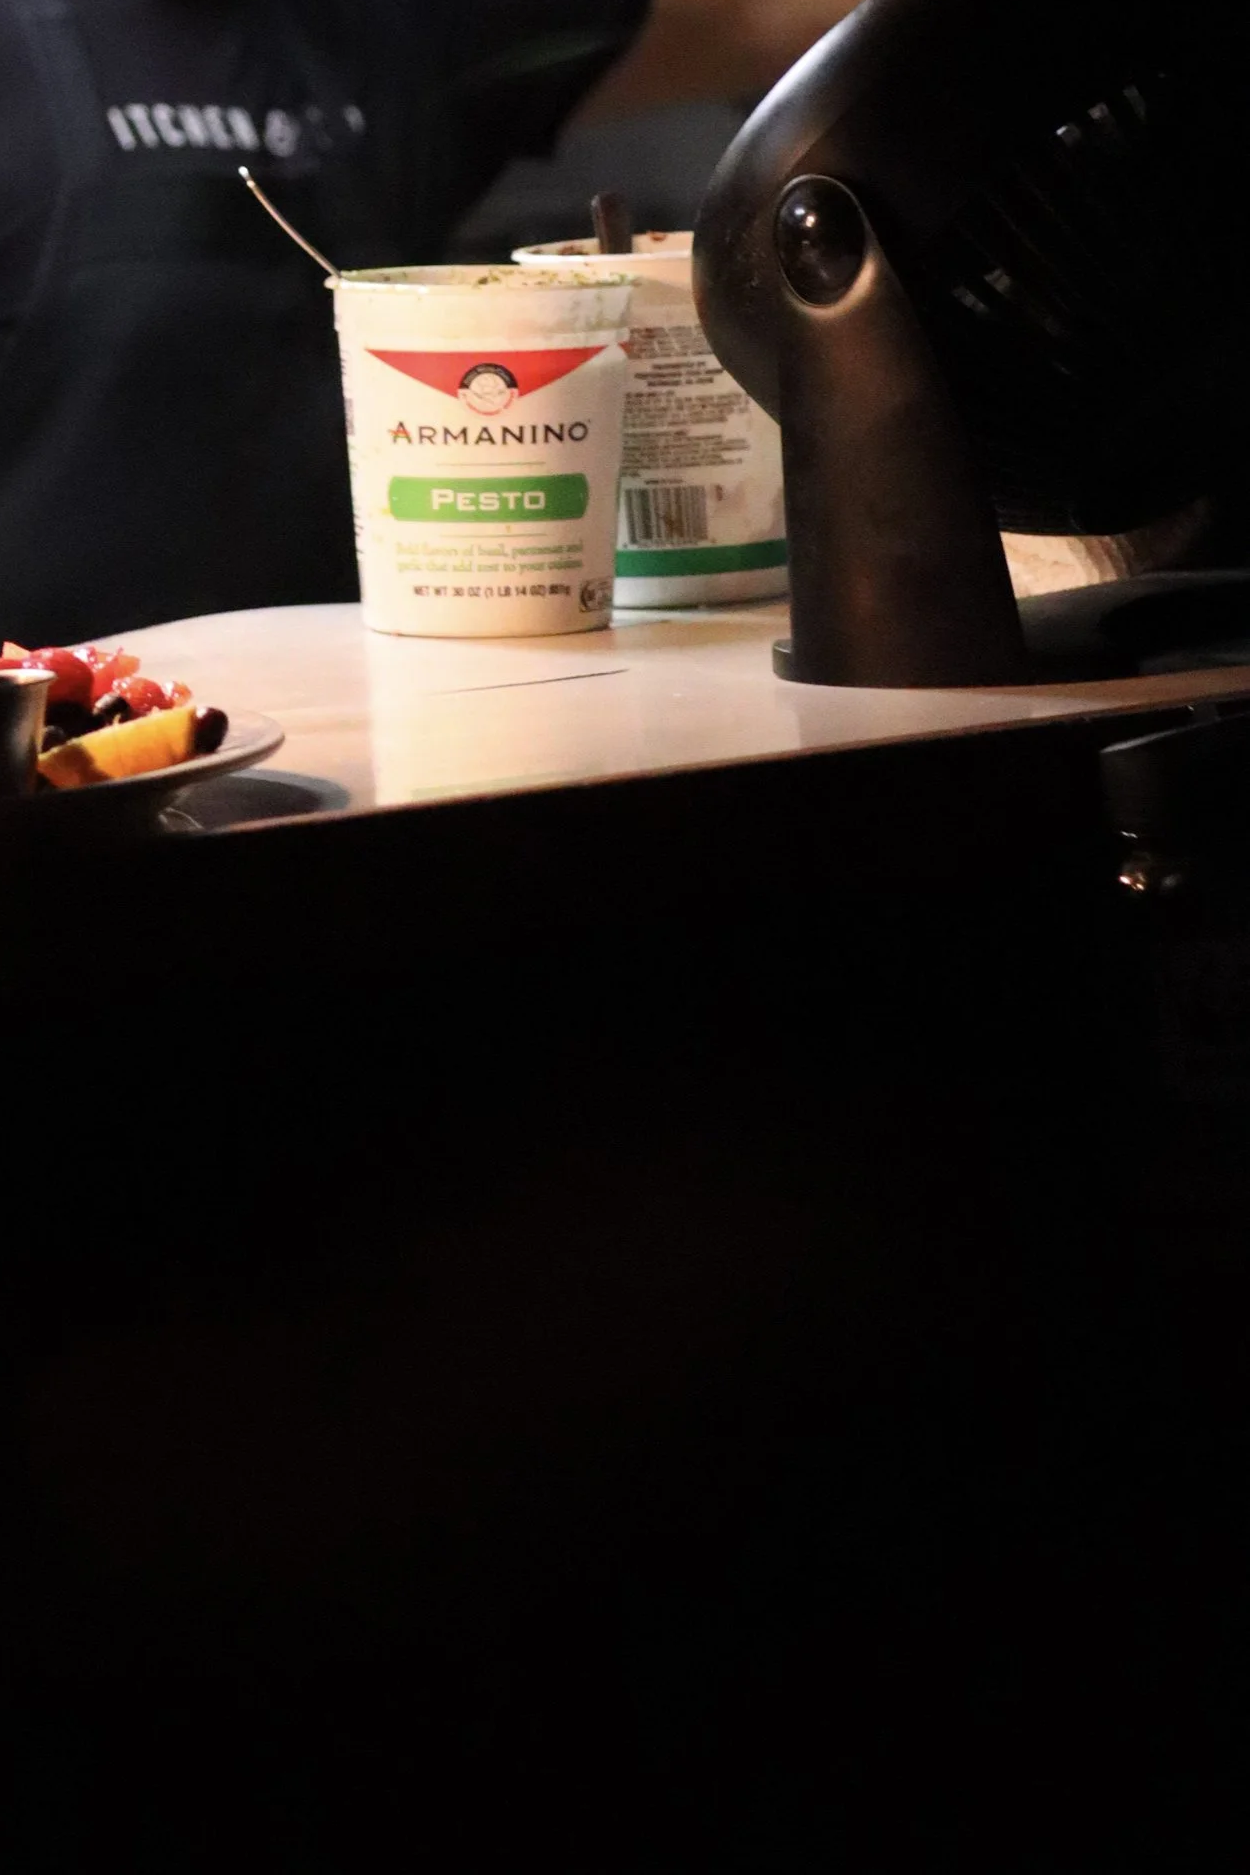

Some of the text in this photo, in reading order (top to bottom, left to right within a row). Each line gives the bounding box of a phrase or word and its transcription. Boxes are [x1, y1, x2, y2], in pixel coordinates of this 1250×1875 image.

[391, 421, 589, 446] ARMANINO
[430, 488, 546, 512] PESTO
[503, 561, 516, 573] to
[413, 585, 429, 597] NET
[467, 585, 482, 598] OZ
[497, 585, 512, 597] LB
